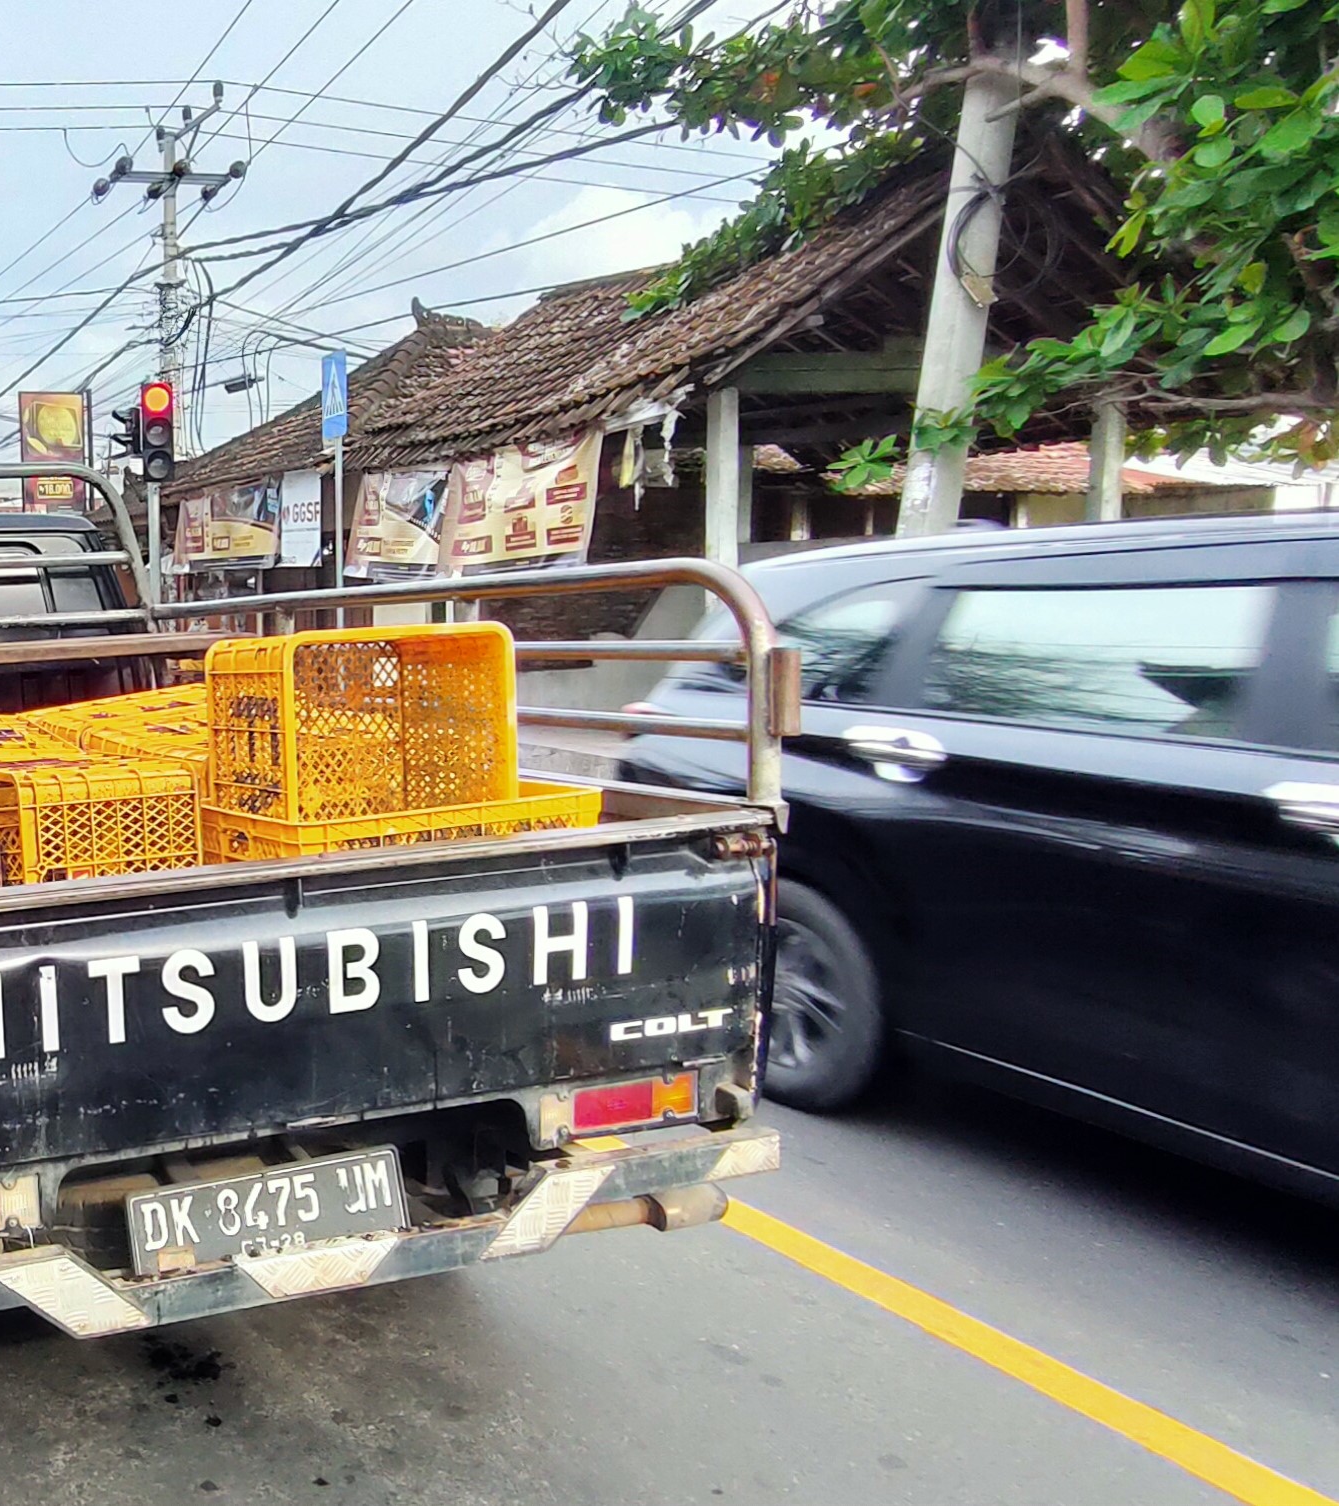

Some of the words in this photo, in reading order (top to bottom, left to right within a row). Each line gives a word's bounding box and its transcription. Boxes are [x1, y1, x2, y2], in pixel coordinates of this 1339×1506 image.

[609, 1008, 734, 1042] COLT
[140, 1195, 200, 1252] DK
[216, 1172, 321, 1236] 8475
